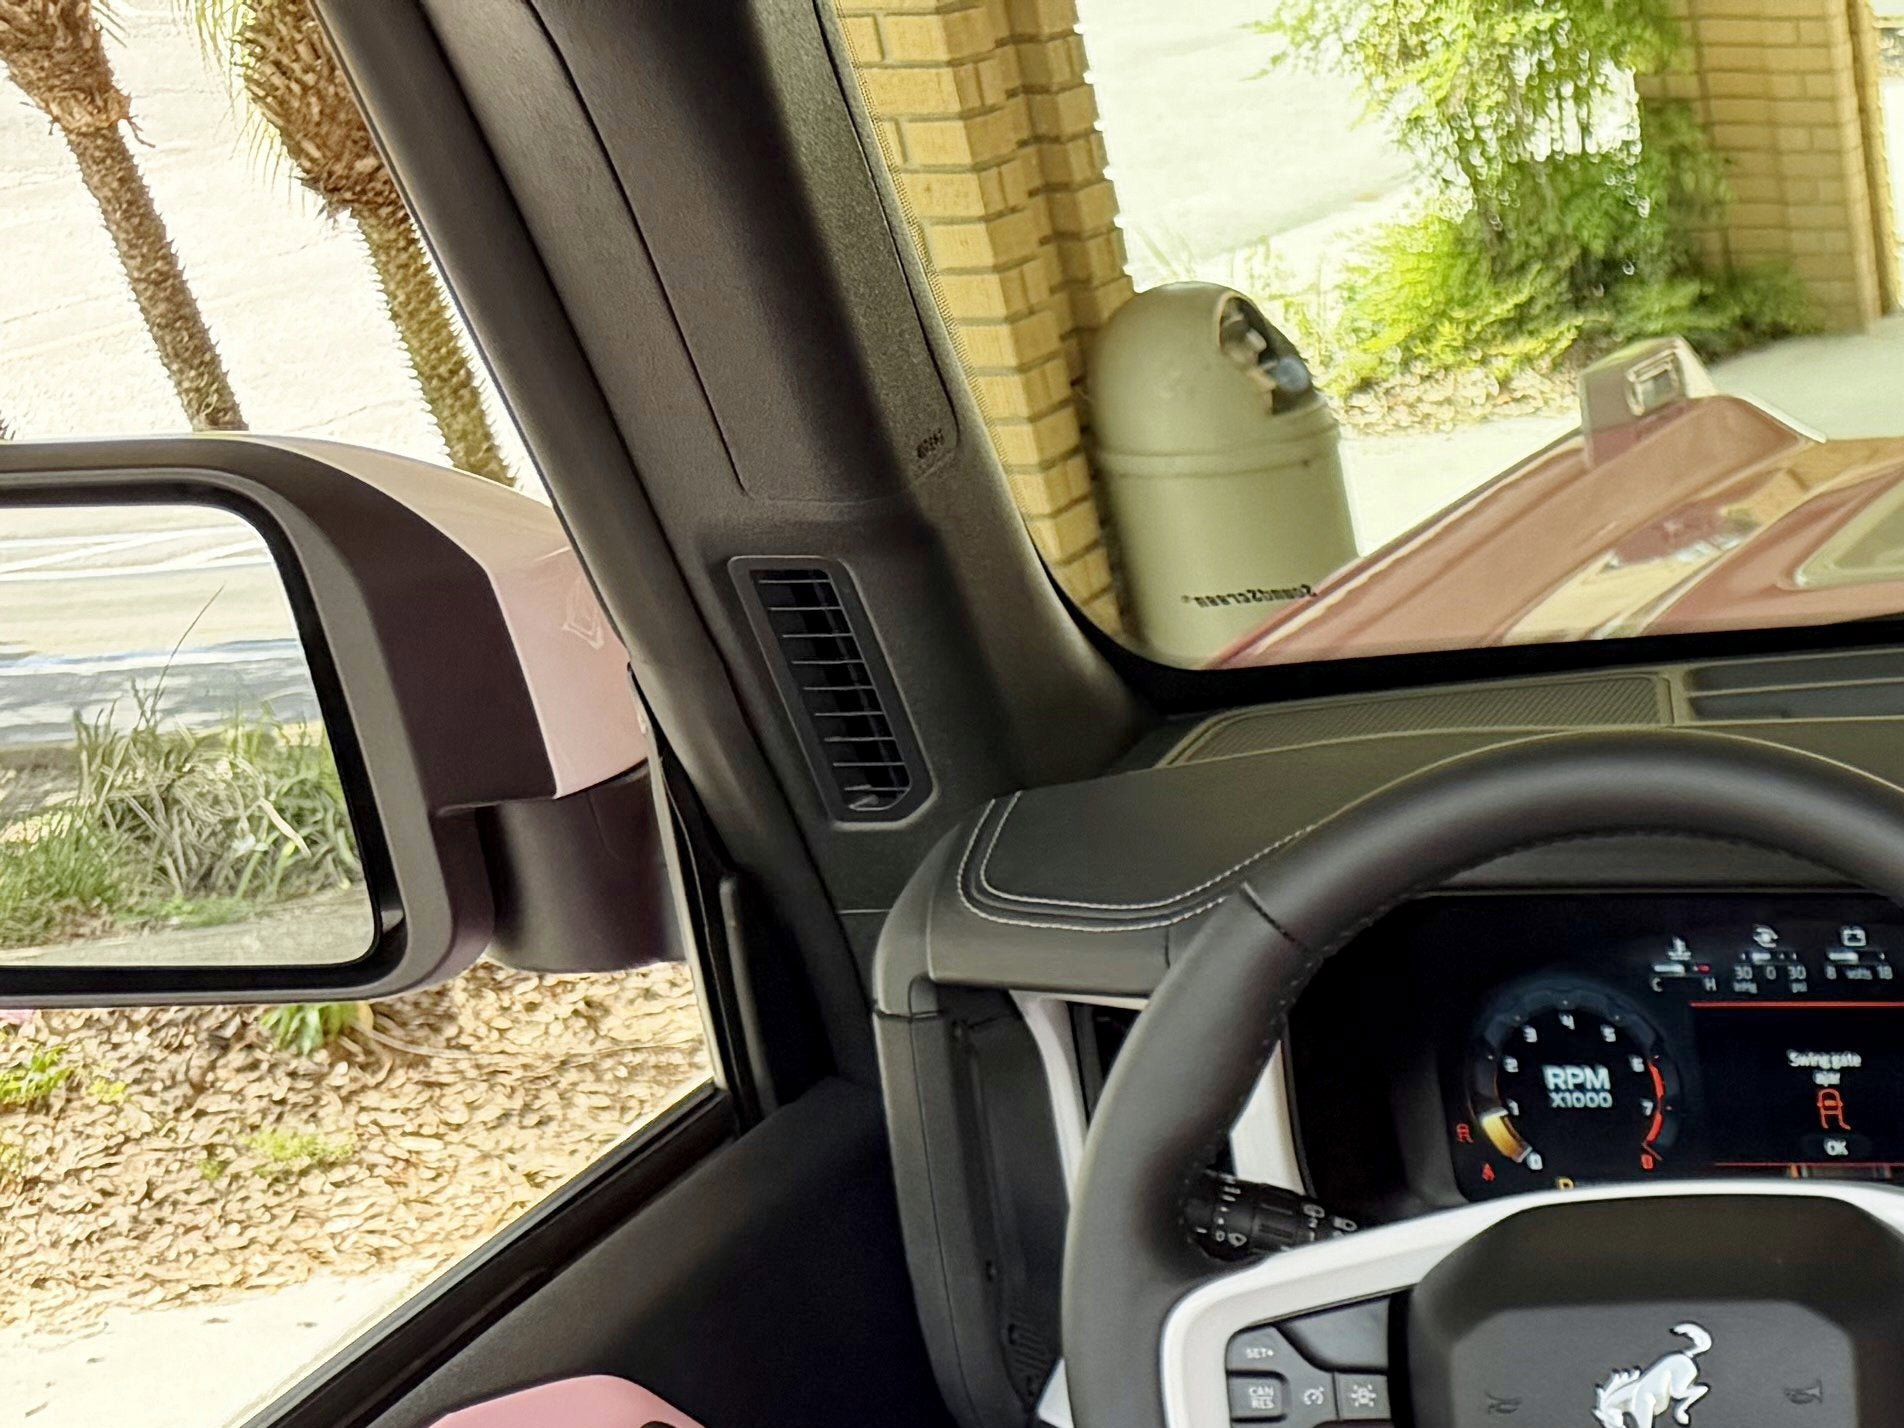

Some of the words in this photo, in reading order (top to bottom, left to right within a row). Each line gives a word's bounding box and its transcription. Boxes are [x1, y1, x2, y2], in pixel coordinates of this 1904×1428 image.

[1651, 977, 1663, 992] C
[1522, 1025, 1538, 1042] 3
[1543, 1064, 1610, 1090] RPM
[1550, 1092, 1613, 1108] X1000
[1640, 1100, 1653, 1116] 7
[1824, 1138, 1849, 1156] OK
[1248, 1386, 1274, 1396] CAN
[1252, 1398, 1275, 1409] RES
